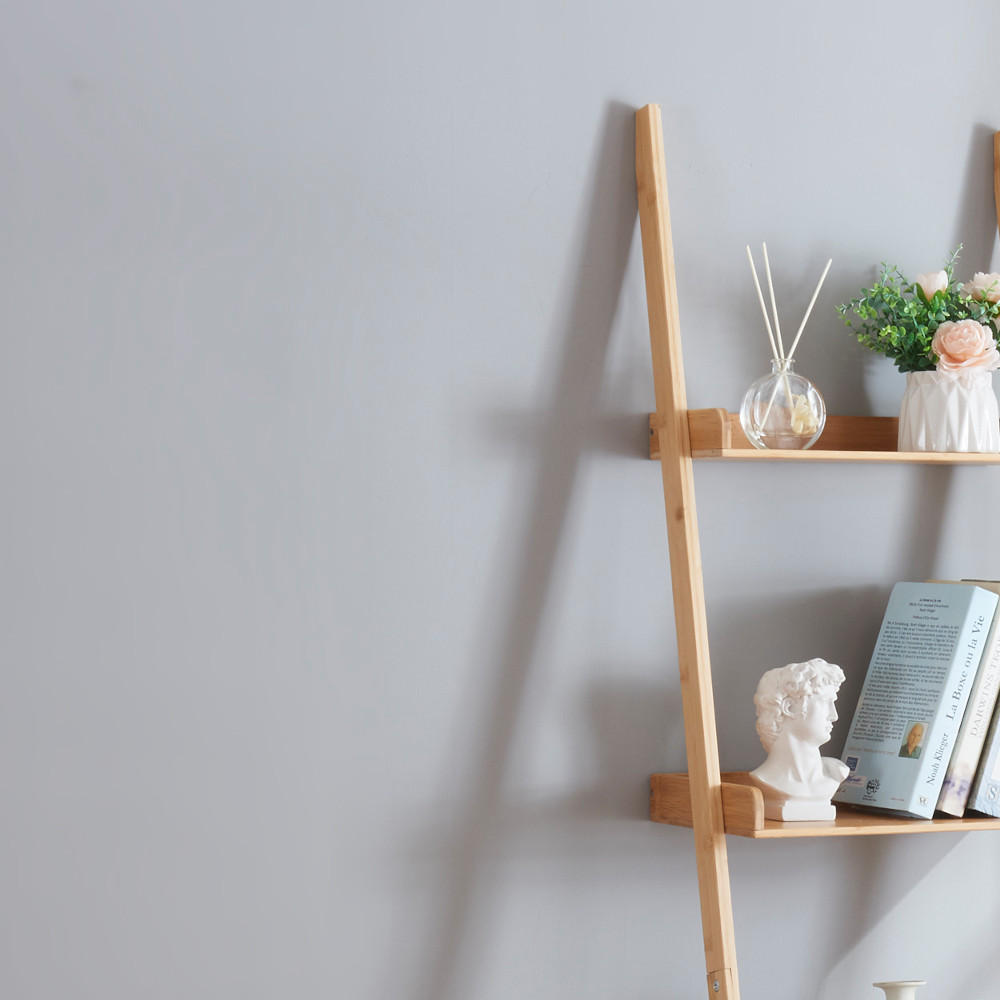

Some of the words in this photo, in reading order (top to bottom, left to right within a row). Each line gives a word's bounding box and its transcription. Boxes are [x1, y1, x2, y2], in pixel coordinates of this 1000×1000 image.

[972, 615, 985, 634] Vie
[964, 652, 974, 668] ou
[952, 670, 968, 701] Boxe
[946, 704, 959, 720] La
[926, 762, 940, 785] Noah
[934, 733, 949, 761] Klieger
